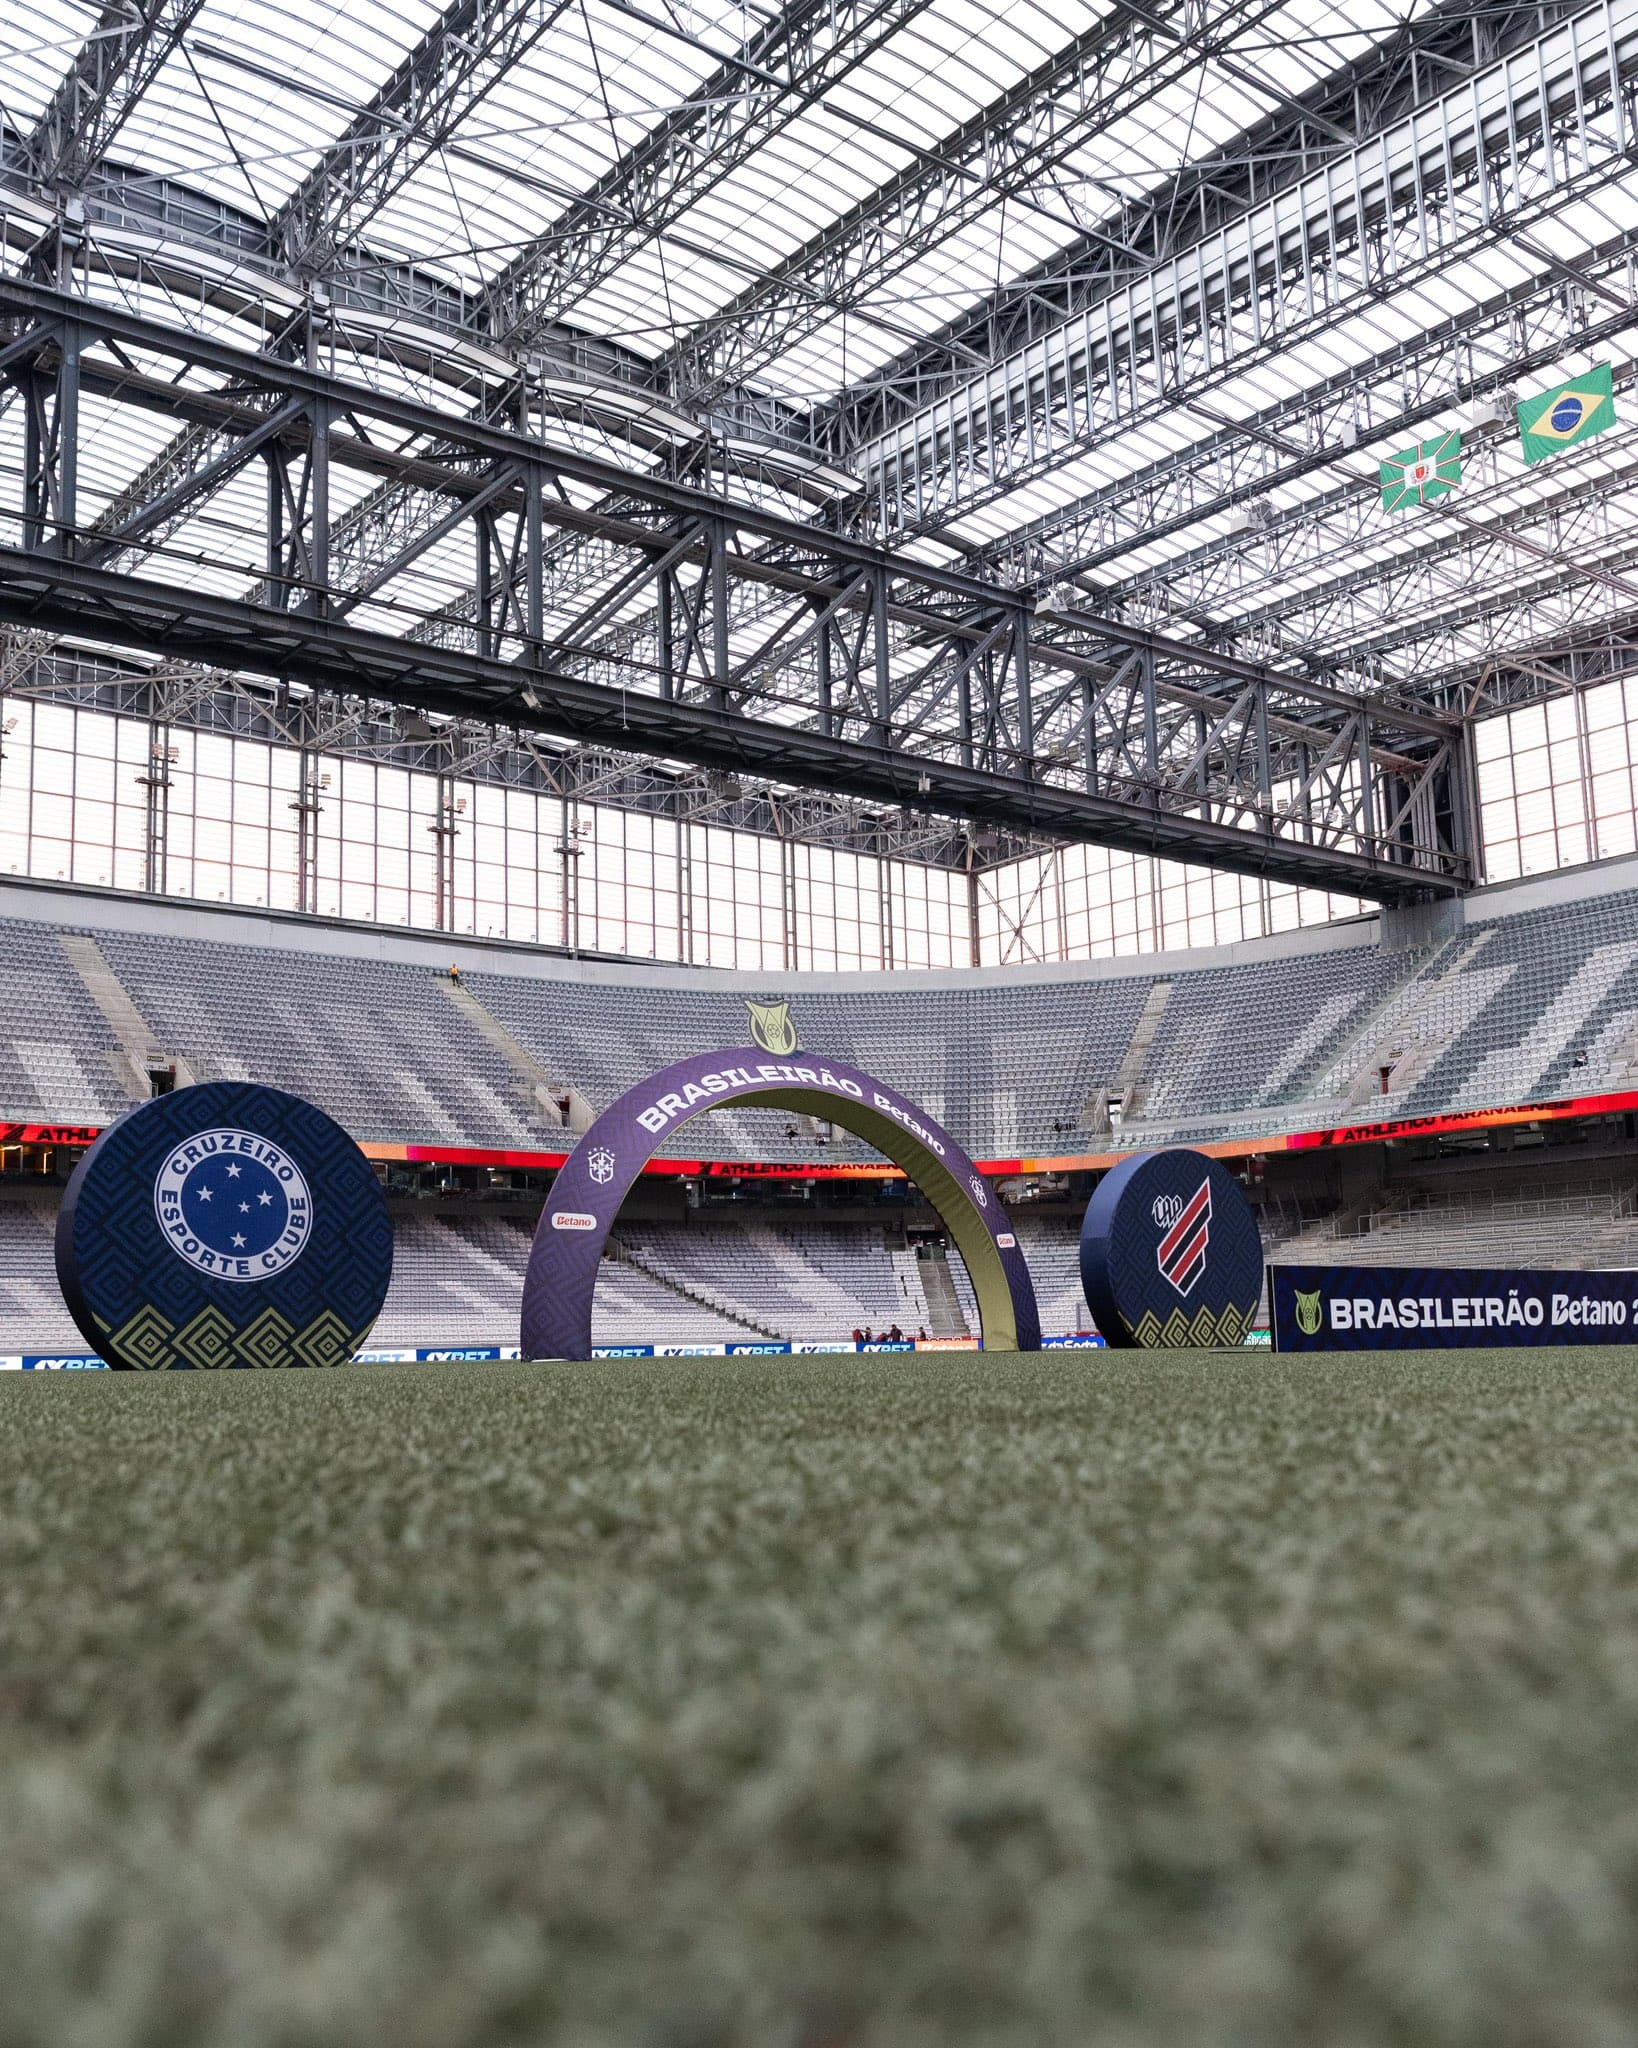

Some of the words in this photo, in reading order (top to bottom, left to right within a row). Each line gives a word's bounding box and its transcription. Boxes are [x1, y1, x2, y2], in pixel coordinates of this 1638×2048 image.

[636, 1065, 863, 1134] BRASILEIRÃO
[873, 1092, 946, 1156] Betano
[37, 1127, 105, 1140] ATHL
[1343, 1116, 1436, 1142] ATHLETICO
[171, 1135, 294, 1181] CRUZEIRO
[720, 1164, 805, 1175] ATHLETICO
[162, 1190, 250, 1275] ESPORTE
[262, 1197, 306, 1269] CLUBE
[557, 1216, 591, 1227] Betano
[1330, 1289, 1544, 1330] BRASILEIRÃO
[1552, 1294, 1627, 1326] Betano
